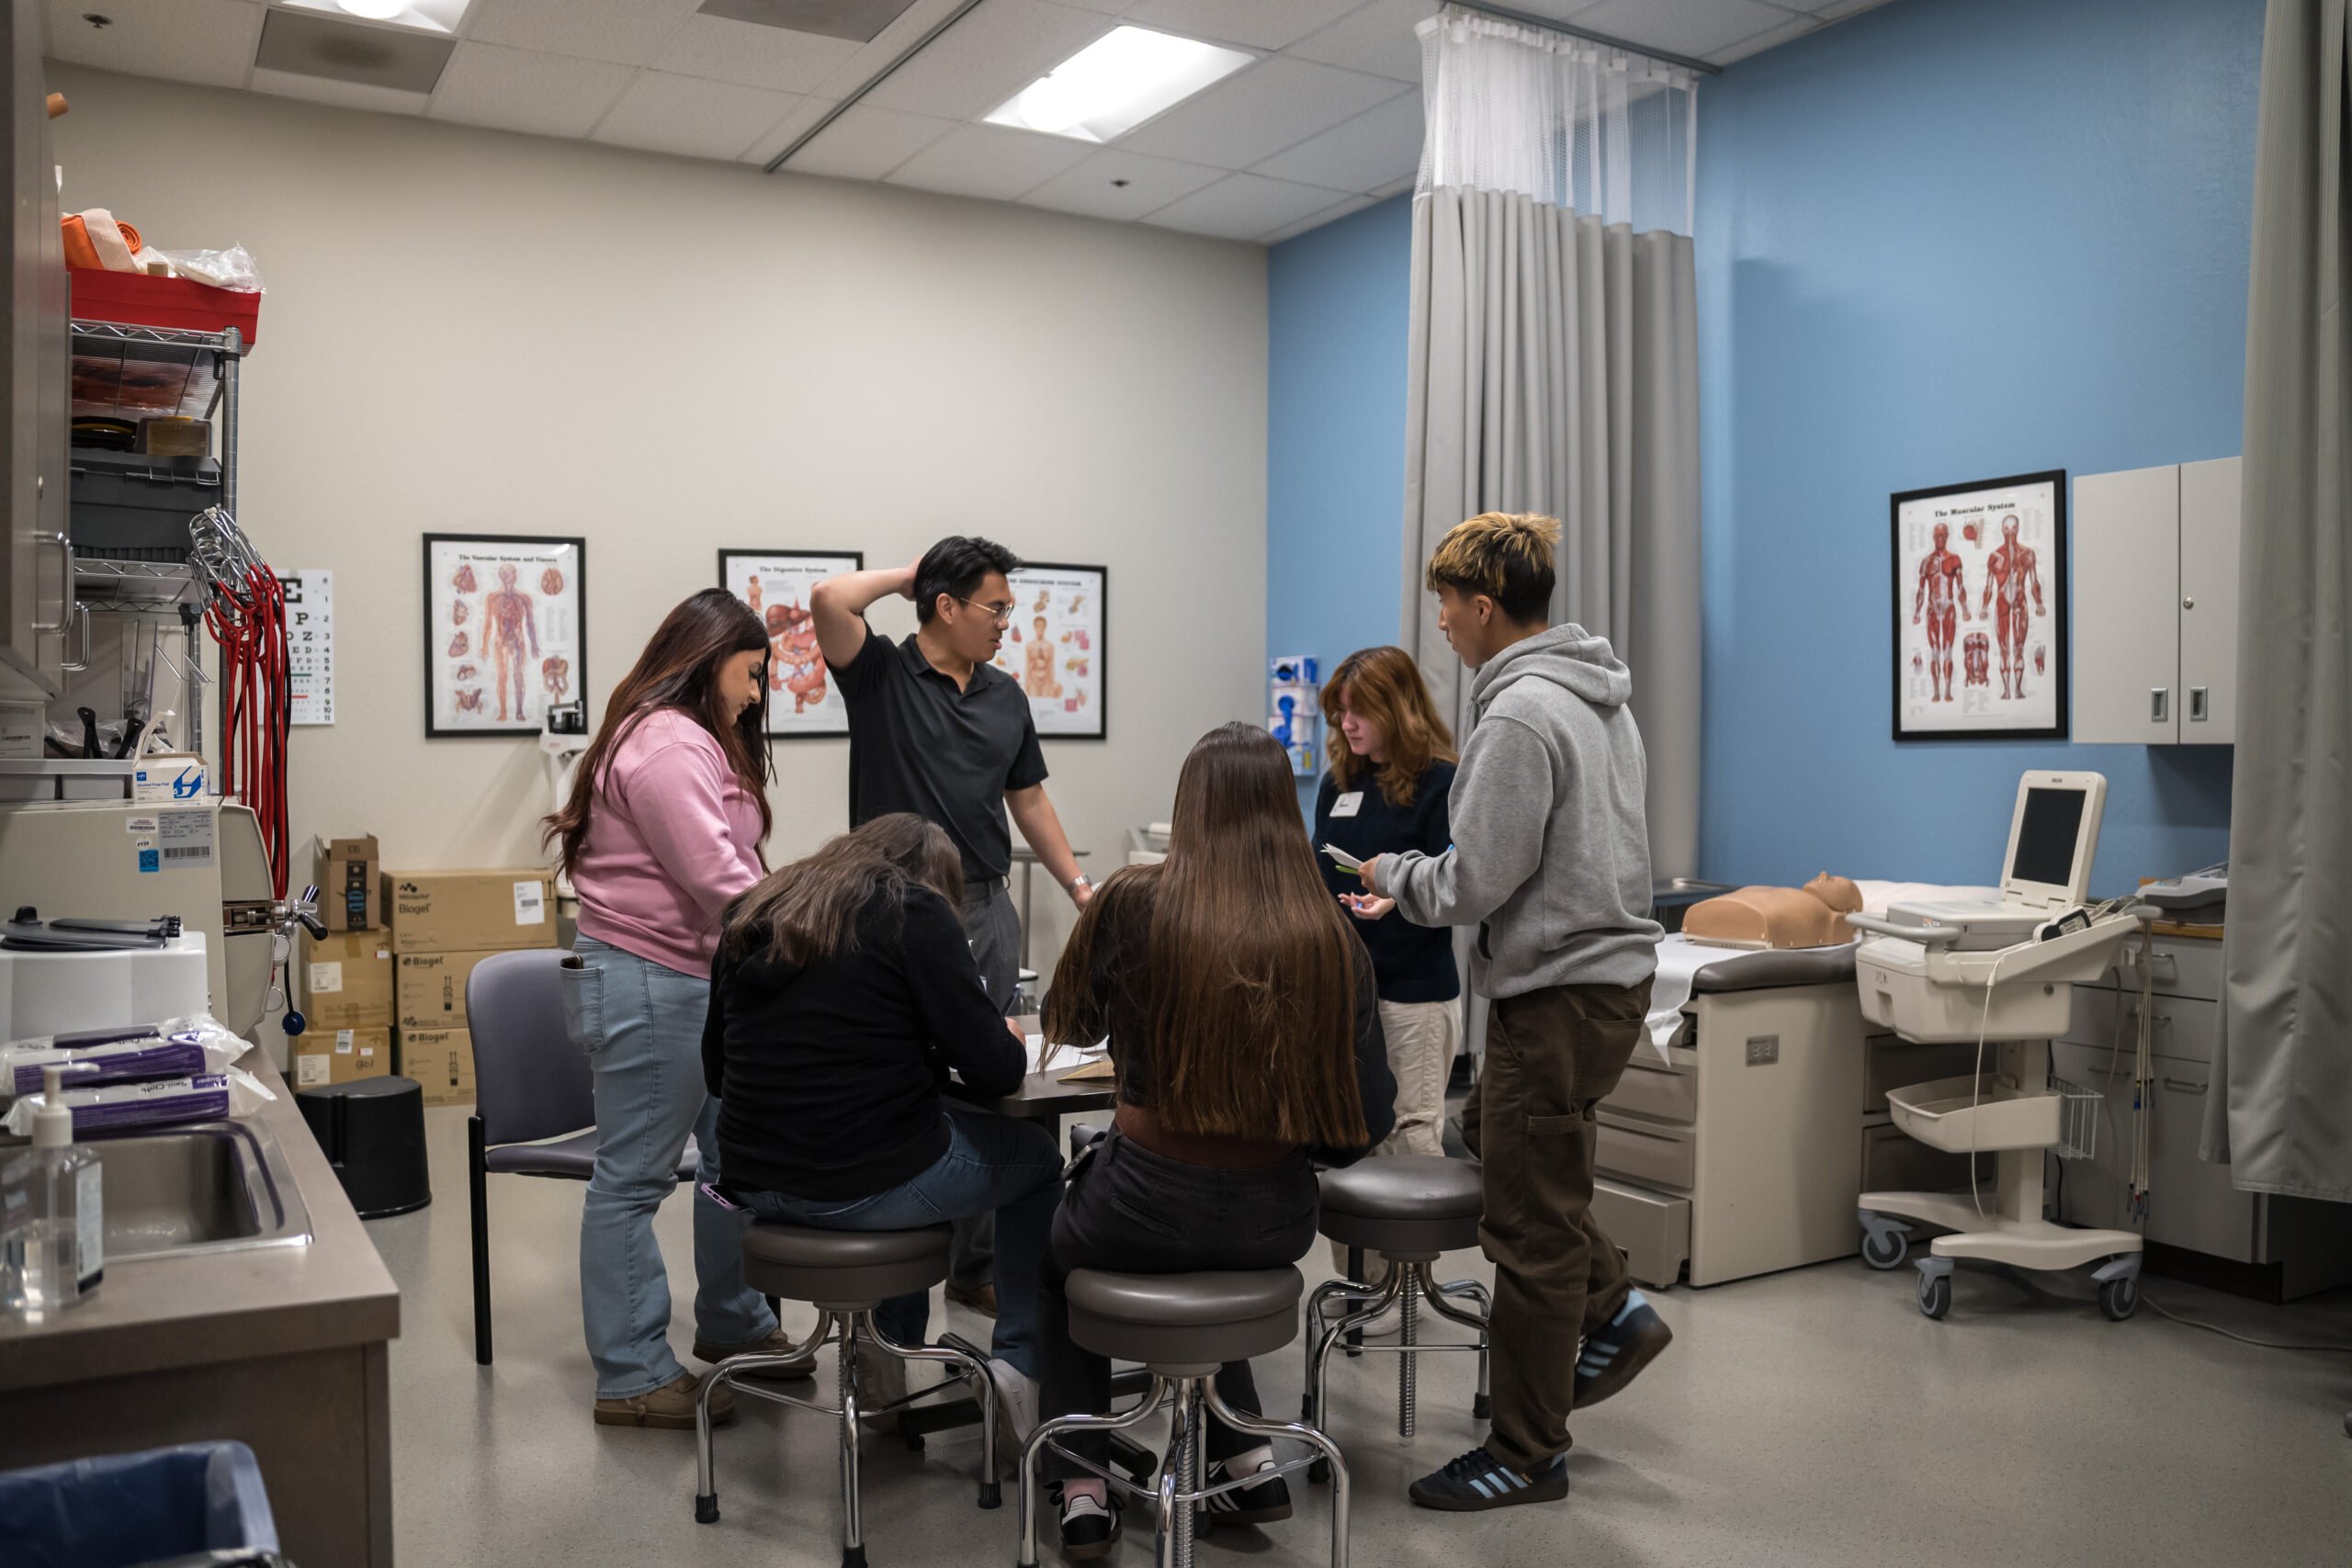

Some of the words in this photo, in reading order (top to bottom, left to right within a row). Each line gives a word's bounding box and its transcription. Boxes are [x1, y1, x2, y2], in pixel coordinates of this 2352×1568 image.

[1934, 510, 1948, 518] The
[1951, 505, 1984, 515] Muscular
[1987, 502, 2016, 513] System
[277, 578, 302, 604] E
[295, 612, 309, 626] P
[286, 631, 294, 640] O
[302, 631, 312, 641] Z
[324, 632, 331, 640] 3
[292, 646, 300, 654] E
[305, 646, 312, 654] D
[399, 903, 430, 915] Biogel
[413, 955, 445, 967] Biogel
[418, 1032, 449, 1043] Biogel
[197, 1076, 221, 1084] Super
